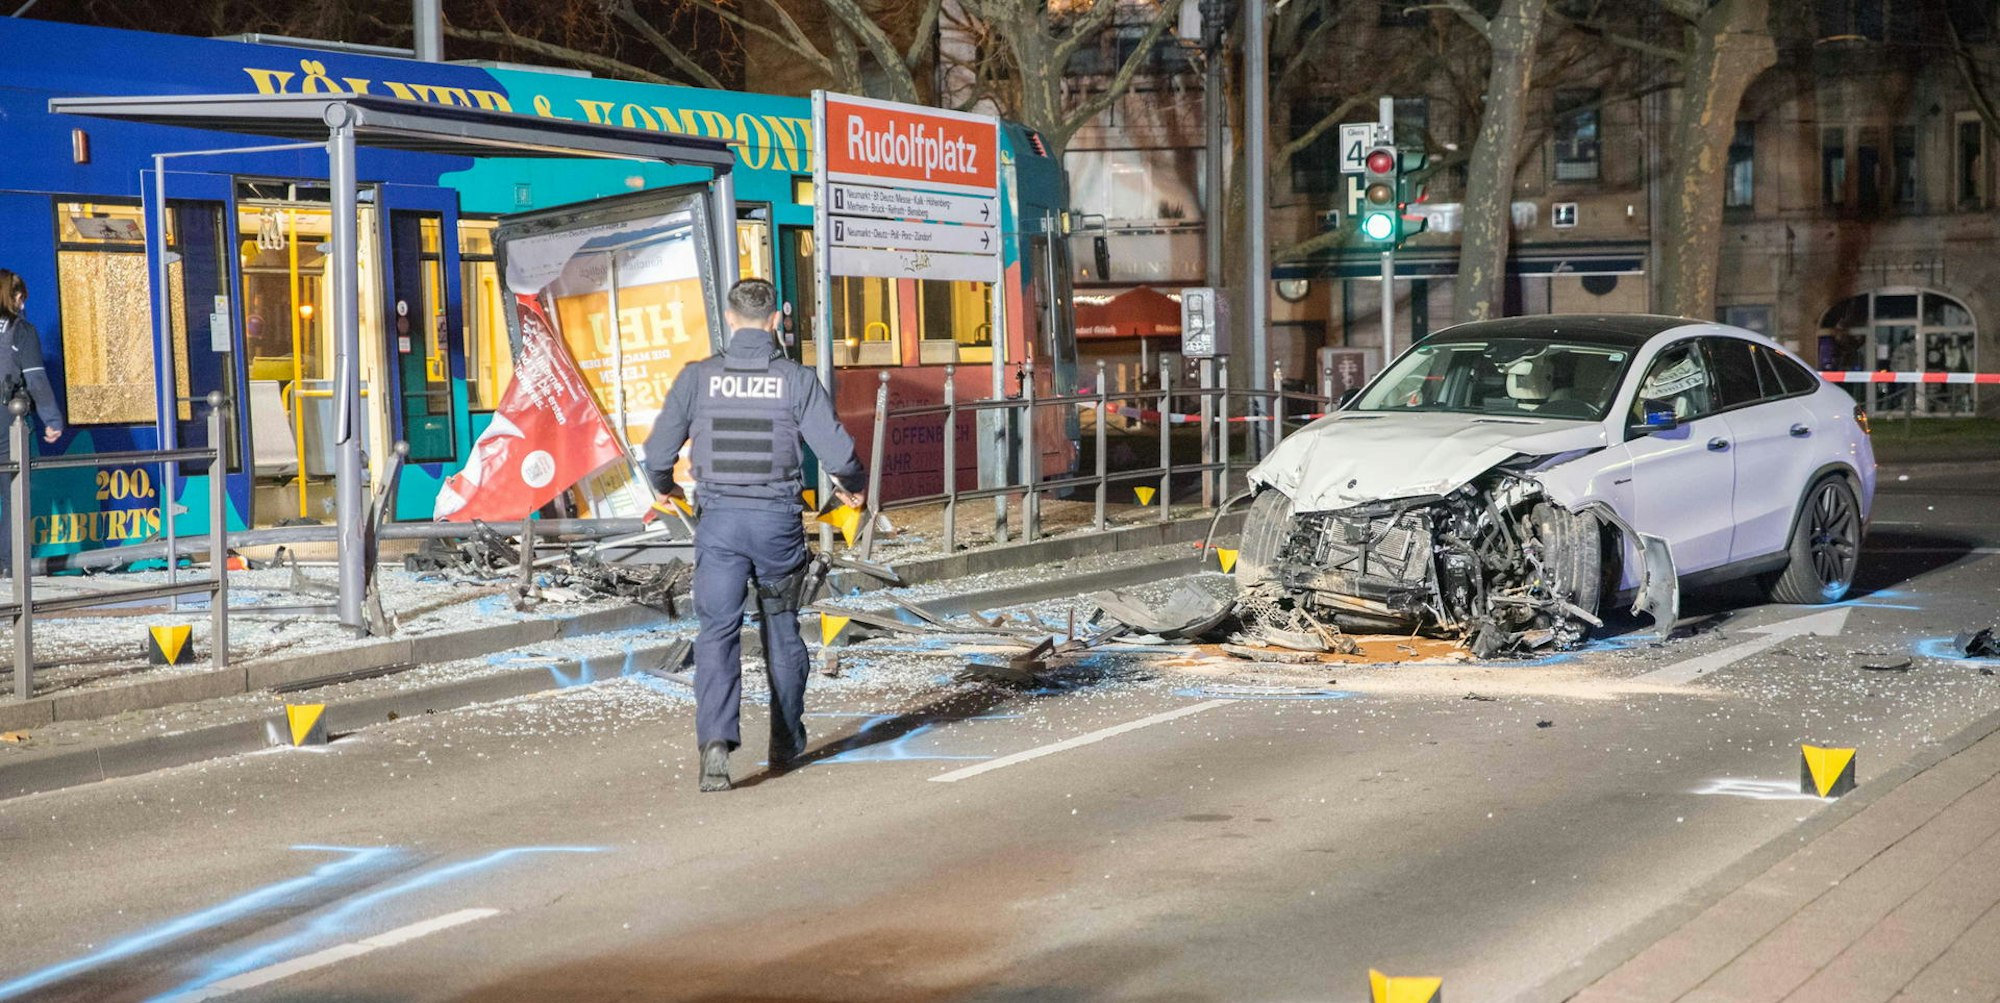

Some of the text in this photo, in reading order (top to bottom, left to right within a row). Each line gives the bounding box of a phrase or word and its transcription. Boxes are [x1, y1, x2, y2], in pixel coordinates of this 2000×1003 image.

[848, 114, 977, 179] Rudolfplatz
[1347, 140, 1365, 167] 4
[836, 190, 842, 208] 1
[846, 189, 871, 198] Neumarkt
[836, 222, 843, 239] 7
[847, 227, 871, 238] Neumarkt
[709, 375, 783, 398] POLIZEI
[892, 424, 969, 446] OFFENBCH
[96, 468, 155, 500] 200.
